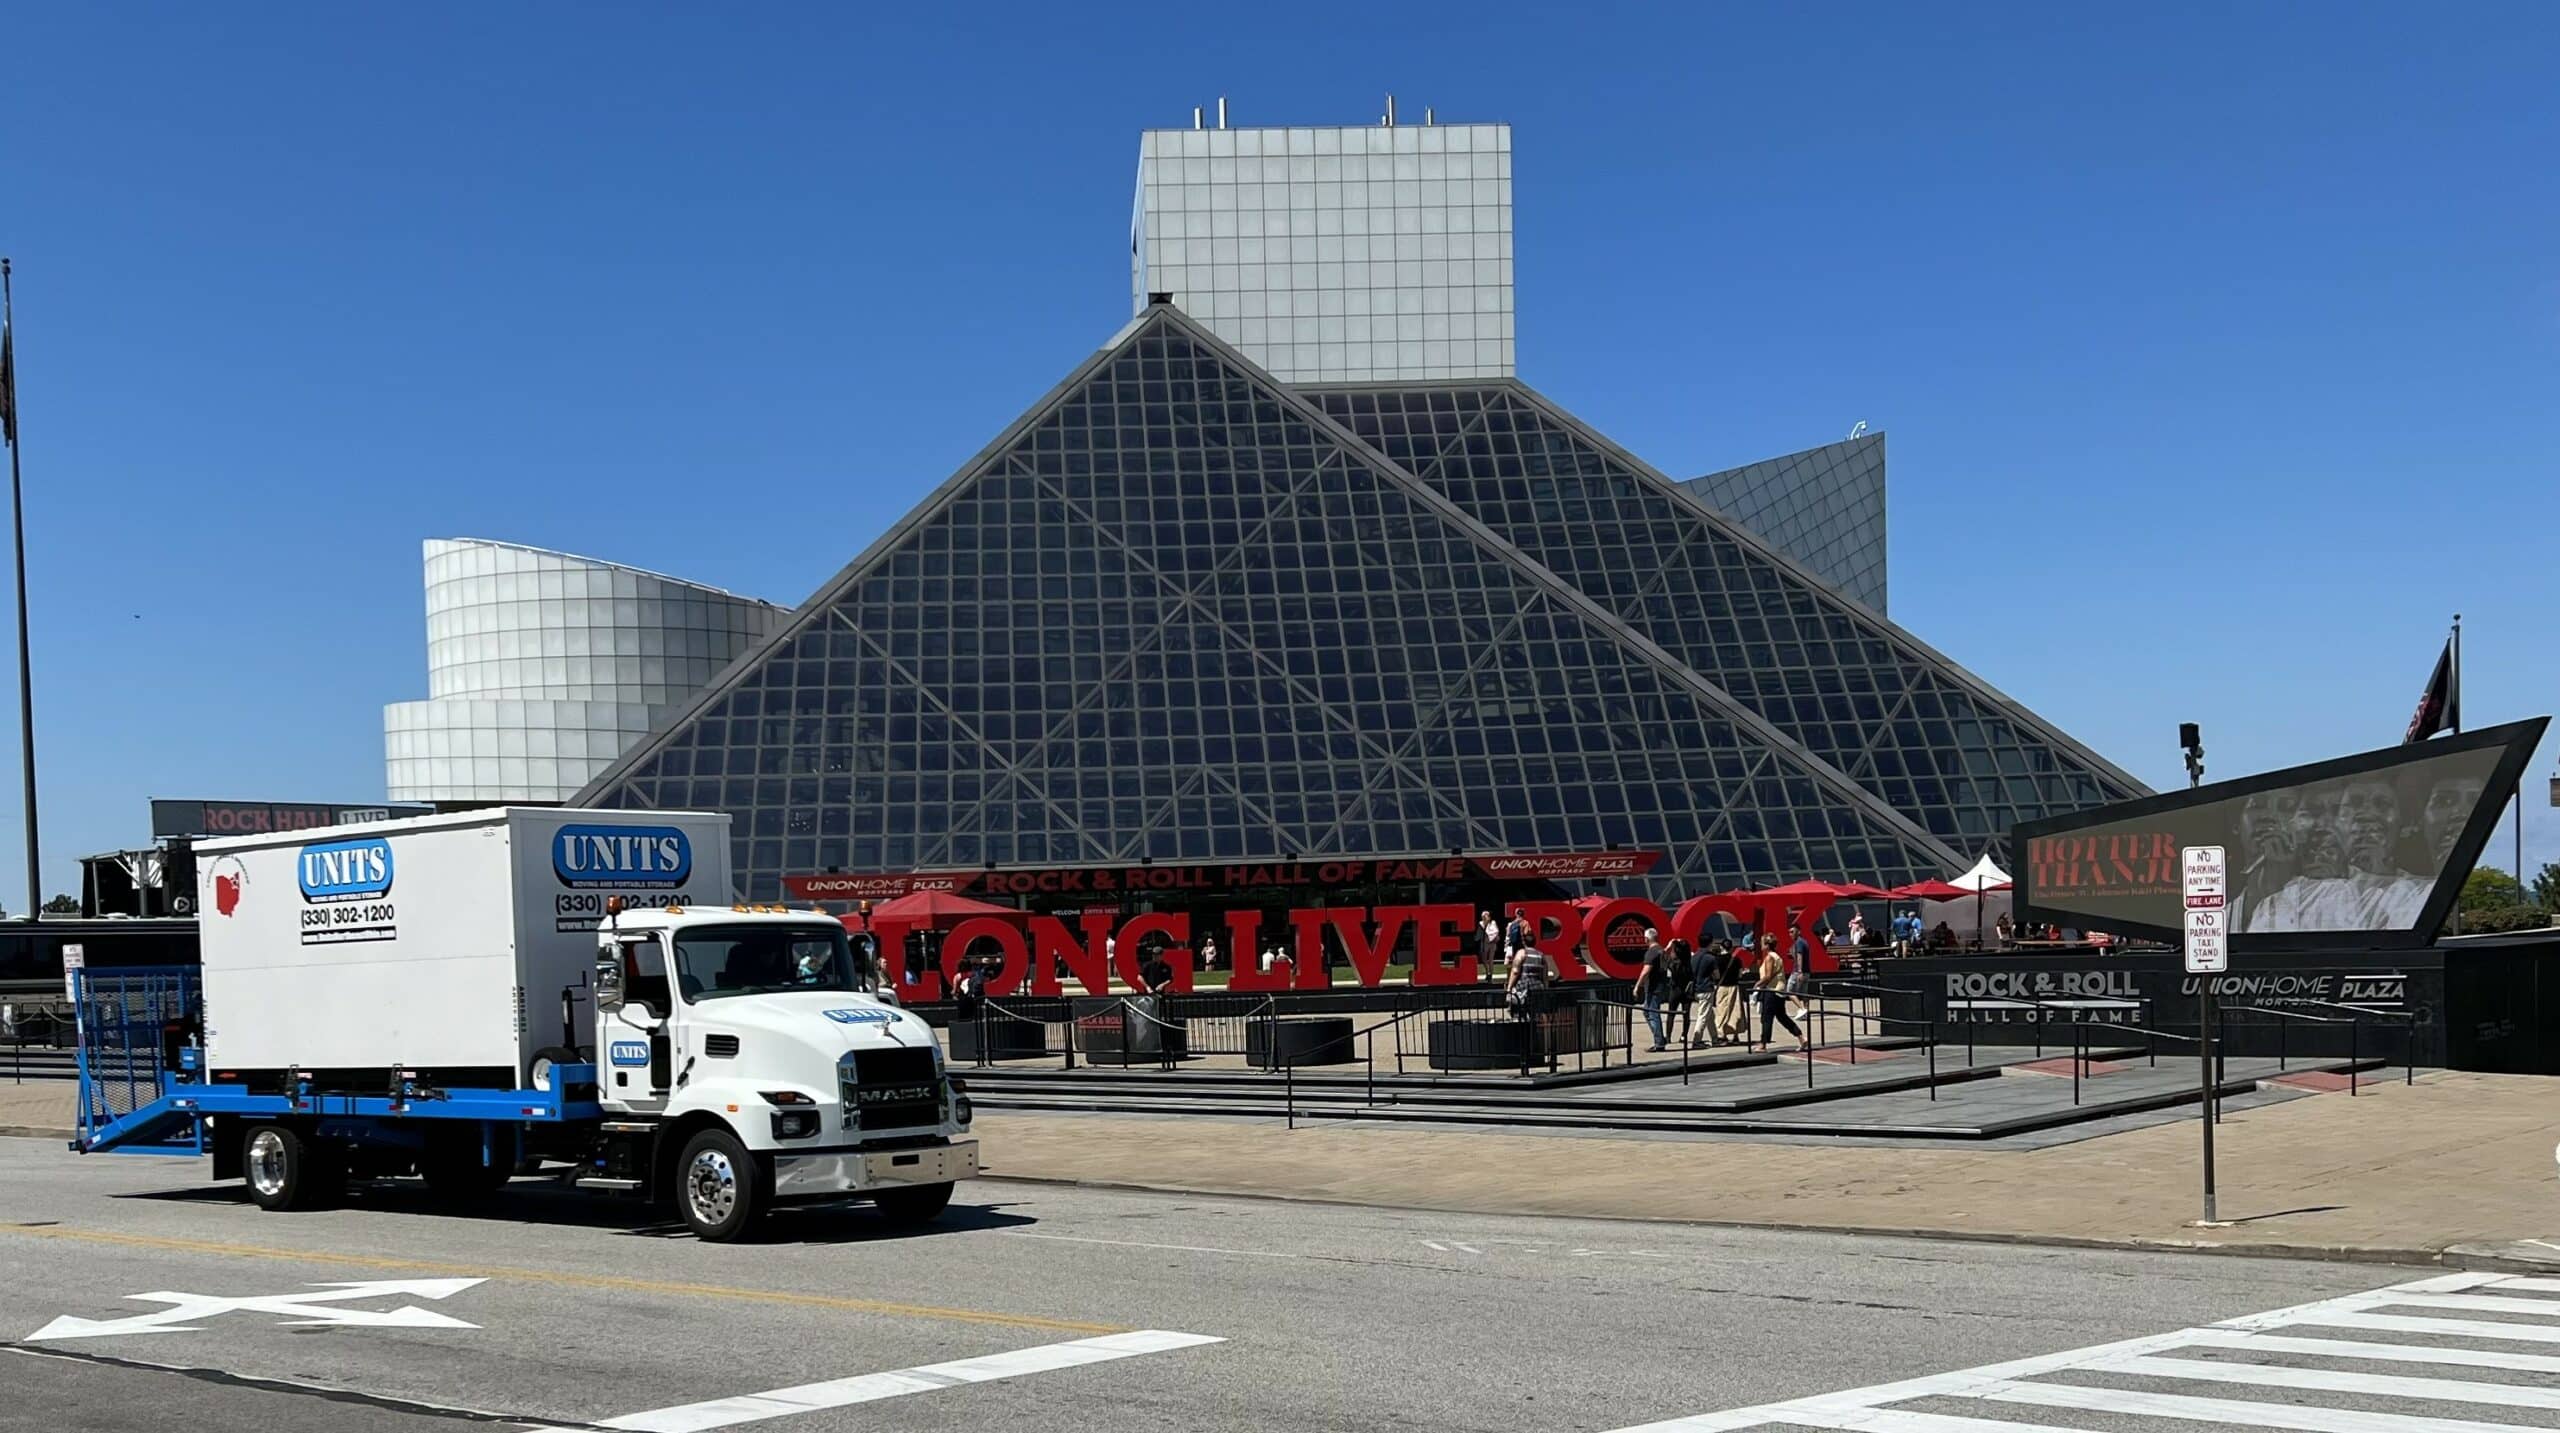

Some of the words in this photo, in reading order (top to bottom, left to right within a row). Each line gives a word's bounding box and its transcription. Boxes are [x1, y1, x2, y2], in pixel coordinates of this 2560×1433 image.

[205, 808, 272, 831] ROCK
[562, 835, 680, 872] UNITS
[2031, 833, 2178, 864] HOTTER
[2196, 851, 2211, 863] NO
[304, 846, 386, 888] UNITS
[1592, 860, 1633, 870] PLAZA
[2187, 864, 2221, 874] PARKING
[985, 871, 1084, 893] ROCK
[1092, 870, 1117, 890] &
[1126, 867, 1213, 888] ROLL
[1224, 864, 1311, 886] HALL
[1318, 861, 1364, 883] OF
[1375, 859, 1465, 881] FAME
[2188, 877, 2203, 886] ANY
[2205, 876, 2221, 885] TIME
[912, 880, 953, 890] PLAZA
[555, 894, 601, 916] (330)
[614, 895, 692, 911] 02-1200
[2187, 896, 2203, 906] FIRE
[2205, 895, 2223, 906] LANE
[301, 907, 330, 929] (330)
[334, 904, 395, 924] 302-1200
[1051, 908, 1080, 916] WELCOME
[2196, 915, 2214, 927] NO
[2190, 928, 2221, 938] PARKING
[875, 912, 1194, 1003] LONG
[1224, 903, 1479, 992] LIVE
[1504, 890, 1841, 982] ROCK
[2197, 939, 2215, 948] TAXI
[2193, 948, 2219, 958] STAND
[1946, 972, 2031, 997] ROCK
[2034, 972, 2057, 996] &
[2063, 971, 2140, 997] ROLL
[2339, 981, 2405, 999] PLAZA
[1947, 1010, 2010, 1023] HALL
[2025, 1010, 2055, 1023] OF
[2071, 1010, 2141, 1023] FAME
[613, 1045, 648, 1058] UNITS
[859, 1087, 931, 1103] MACK
